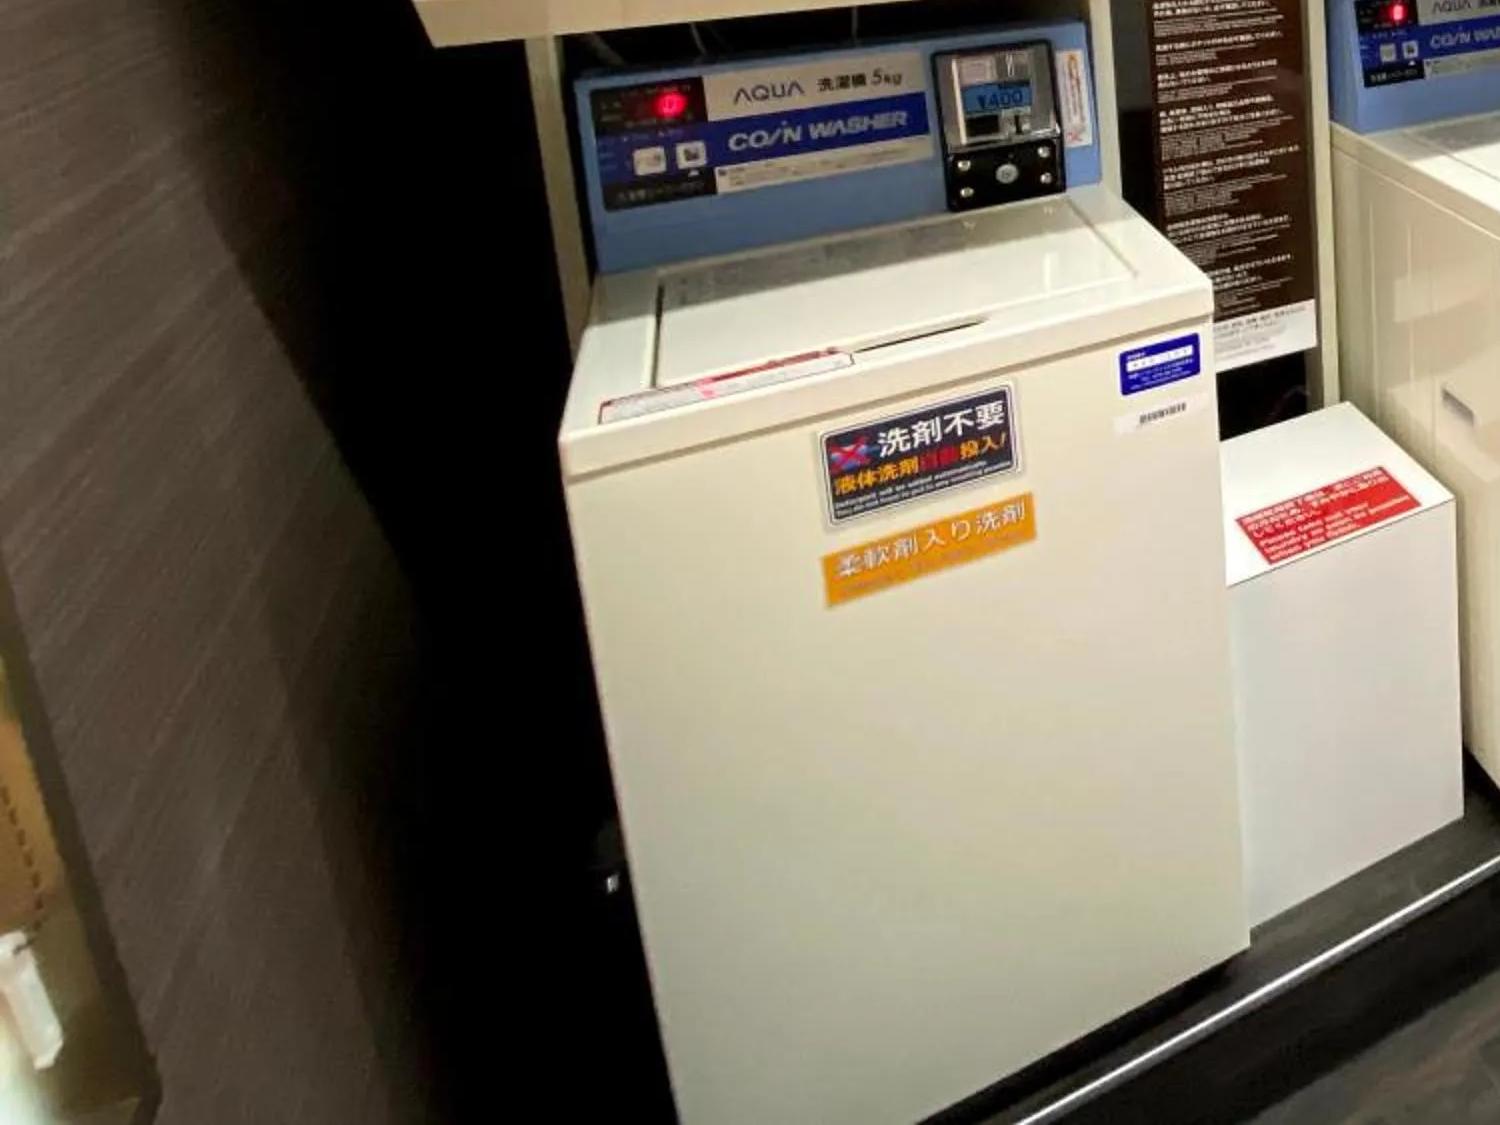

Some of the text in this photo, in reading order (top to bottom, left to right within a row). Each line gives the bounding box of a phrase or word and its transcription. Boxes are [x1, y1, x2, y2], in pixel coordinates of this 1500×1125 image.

[734, 80, 804, 105] AQUA
[809, 110, 908, 139] WASHER
[878, 400, 1005, 457] 洗剤不要
[838, 502, 1026, 577] 柔軟剤入り洗剤
